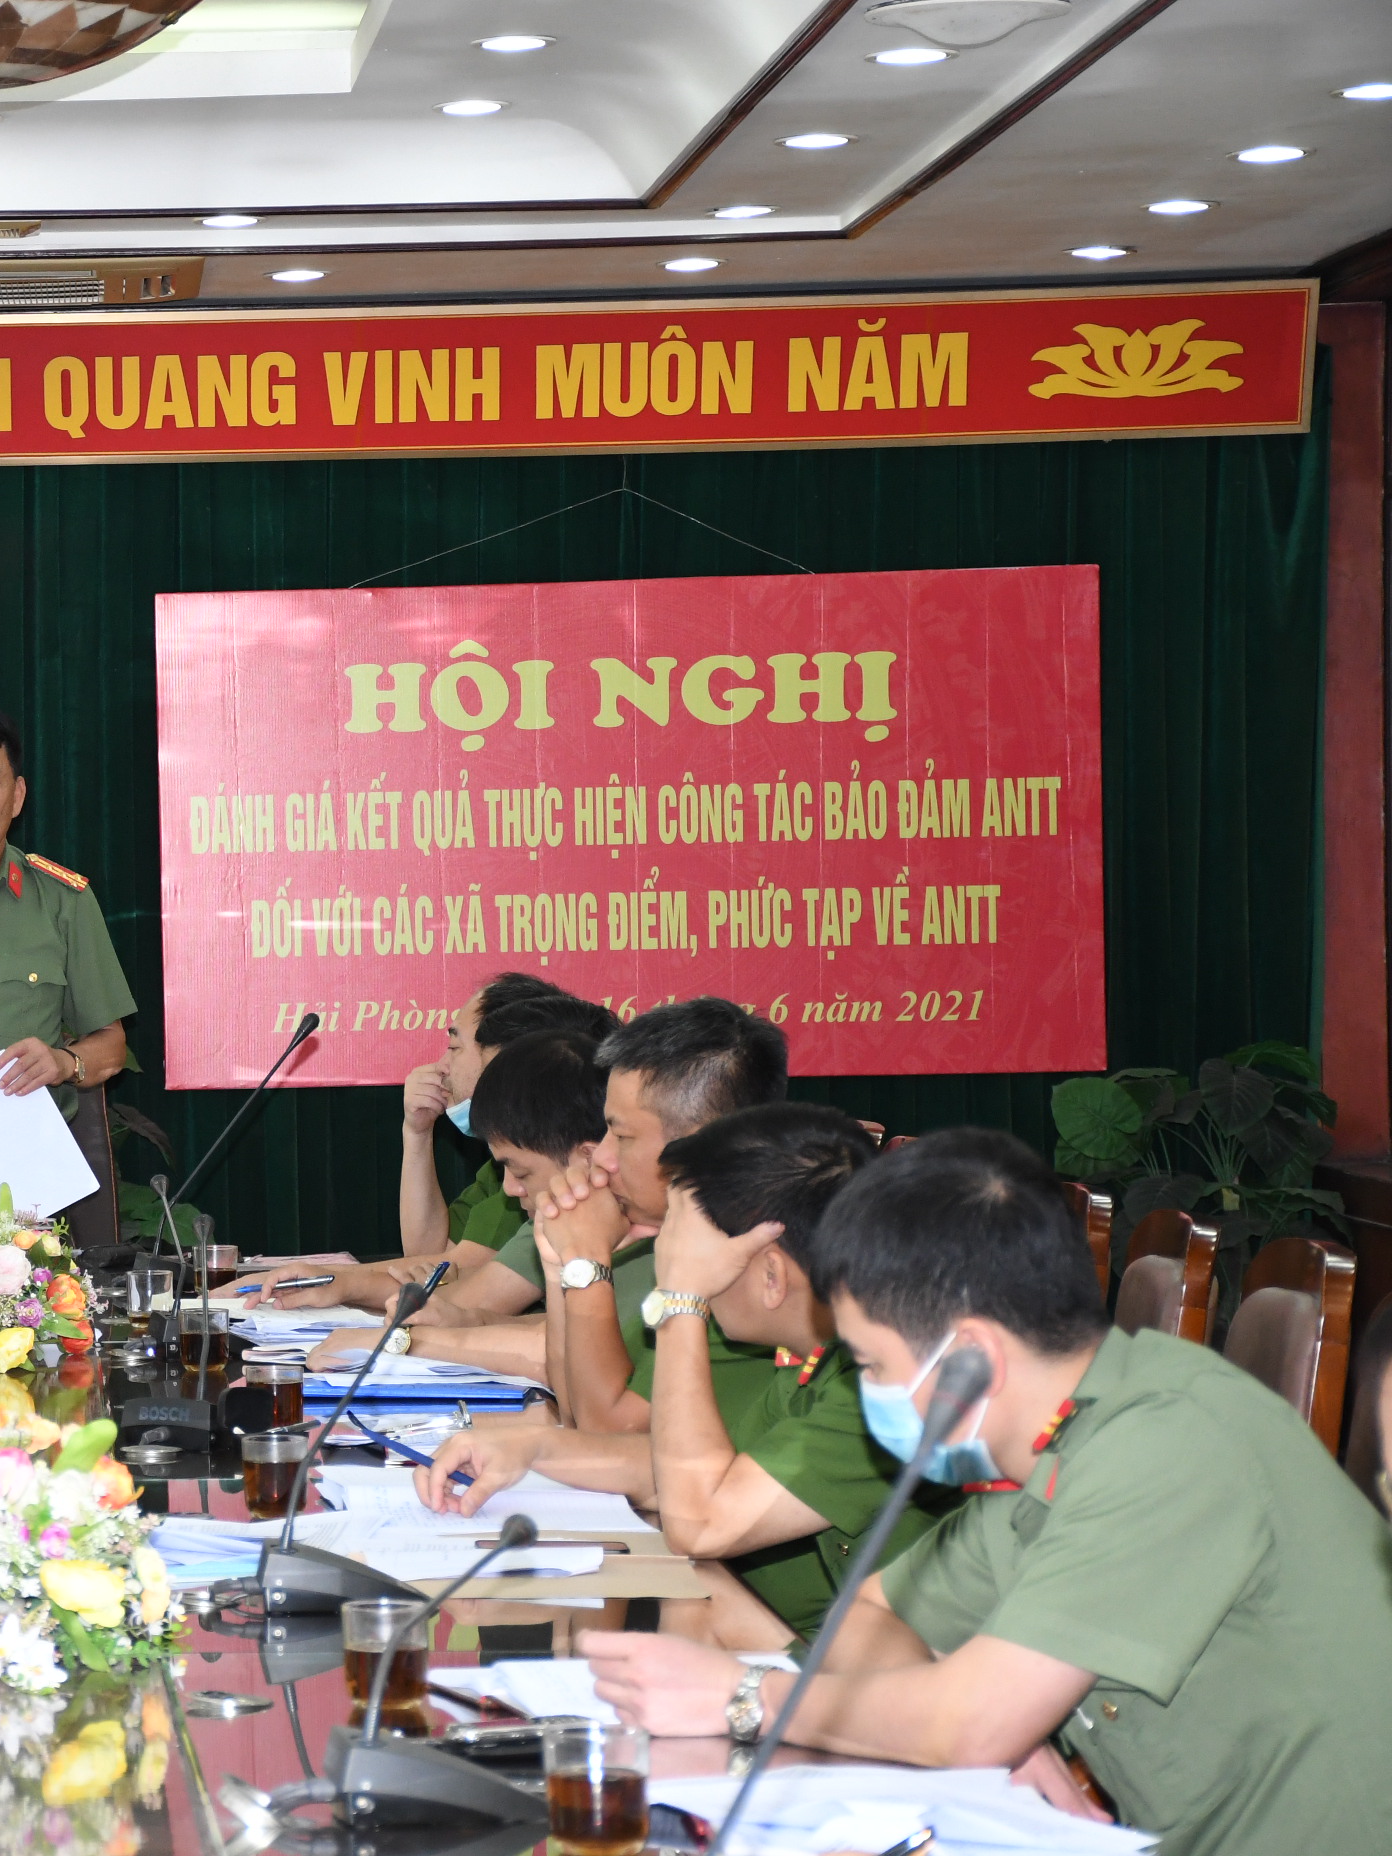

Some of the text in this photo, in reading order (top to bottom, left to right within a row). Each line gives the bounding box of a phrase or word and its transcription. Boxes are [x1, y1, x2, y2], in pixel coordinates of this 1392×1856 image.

[44, 351, 297, 439] QUANG
[324, 347, 500, 426] VINH
[536, 324, 754, 419] MUÔN
[789, 318, 969, 412] NĂM
[344, 639, 898, 752] HỘI NGHỊ
[189, 757, 1061, 861] ĐÁNH GIÁ KẾT QUẢ THỰC HIỆN CÔNG TÁC BẢO ĐẢM ANTT
[251, 866, 1001, 966] ĐỐI VỚI CÁC XÃ TRỌNG ĐIỂM, PHỨC TẠP VỀ ANTT
[769, 992, 790, 1025] 6
[801, 991, 884, 1024] năm
[895, 990, 985, 1022] 2021
[138, 1406, 191, 1422] BOSCH
